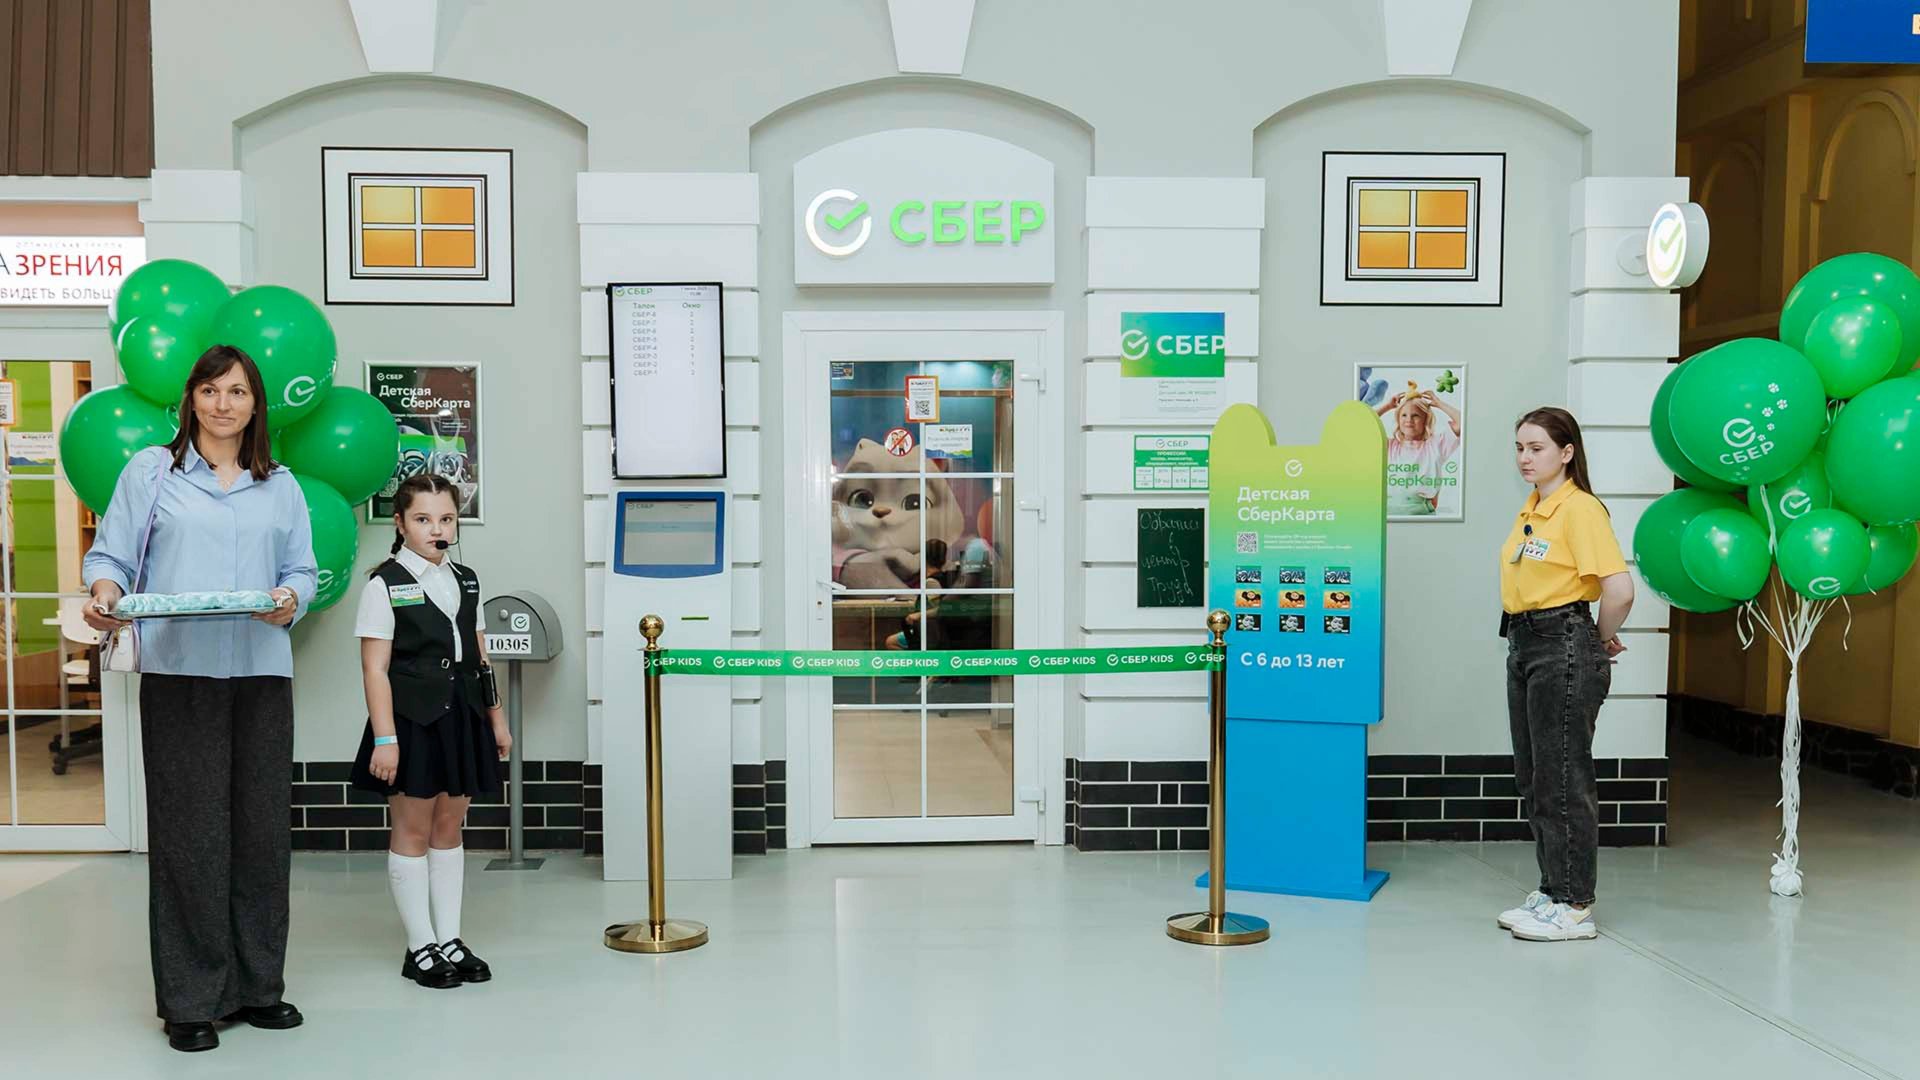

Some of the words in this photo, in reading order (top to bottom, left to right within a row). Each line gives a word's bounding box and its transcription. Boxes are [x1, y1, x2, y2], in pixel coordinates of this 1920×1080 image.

[889, 200, 1046, 246] СБЕР
[15, 254, 122, 276] ЗРЕНИЯ
[62, 287, 118, 300] БОЛЬШ
[627, 287, 653, 295] СБЕР
[1155, 335, 1224, 355] СБЕР
[379, 385, 432, 397] Детская
[401, 397, 471, 410] СберКарта
[1719, 441, 1774, 465] СБЕР
[1387, 463, 1420, 472] ская
[1388, 474, 1457, 489] берКарта
[1237, 486, 1310, 503] Детская
[1238, 506, 1335, 525] СберКарта
[489, 638, 529, 651] 10305
[677, 657, 702, 666] KIDS
[728, 658, 755, 667] СБЕР
[757, 658, 782, 667] KIDS
[807, 658, 834, 667] СБЕР
[836, 658, 861, 667] KIDS
[886, 658, 913, 667] СБЕР
[915, 658, 940, 667] KIDS
[964, 658, 992, 667] СБЕР
[993, 657, 1018, 666] KIDS
[1043, 657, 1070, 666] СБЕР
[1072, 656, 1096, 665] KIDS
[1121, 655, 1148, 664] СБЕР
[1150, 654, 1174, 664] KIDS
[1199, 653, 1225, 662] СБЕР
[1240, 652, 1253, 666] С
[1257, 652, 1267, 666] 6
[1271, 656, 1292, 668] до
[1296, 654, 1312, 668] 13
[1317, 657, 1345, 669] лет
